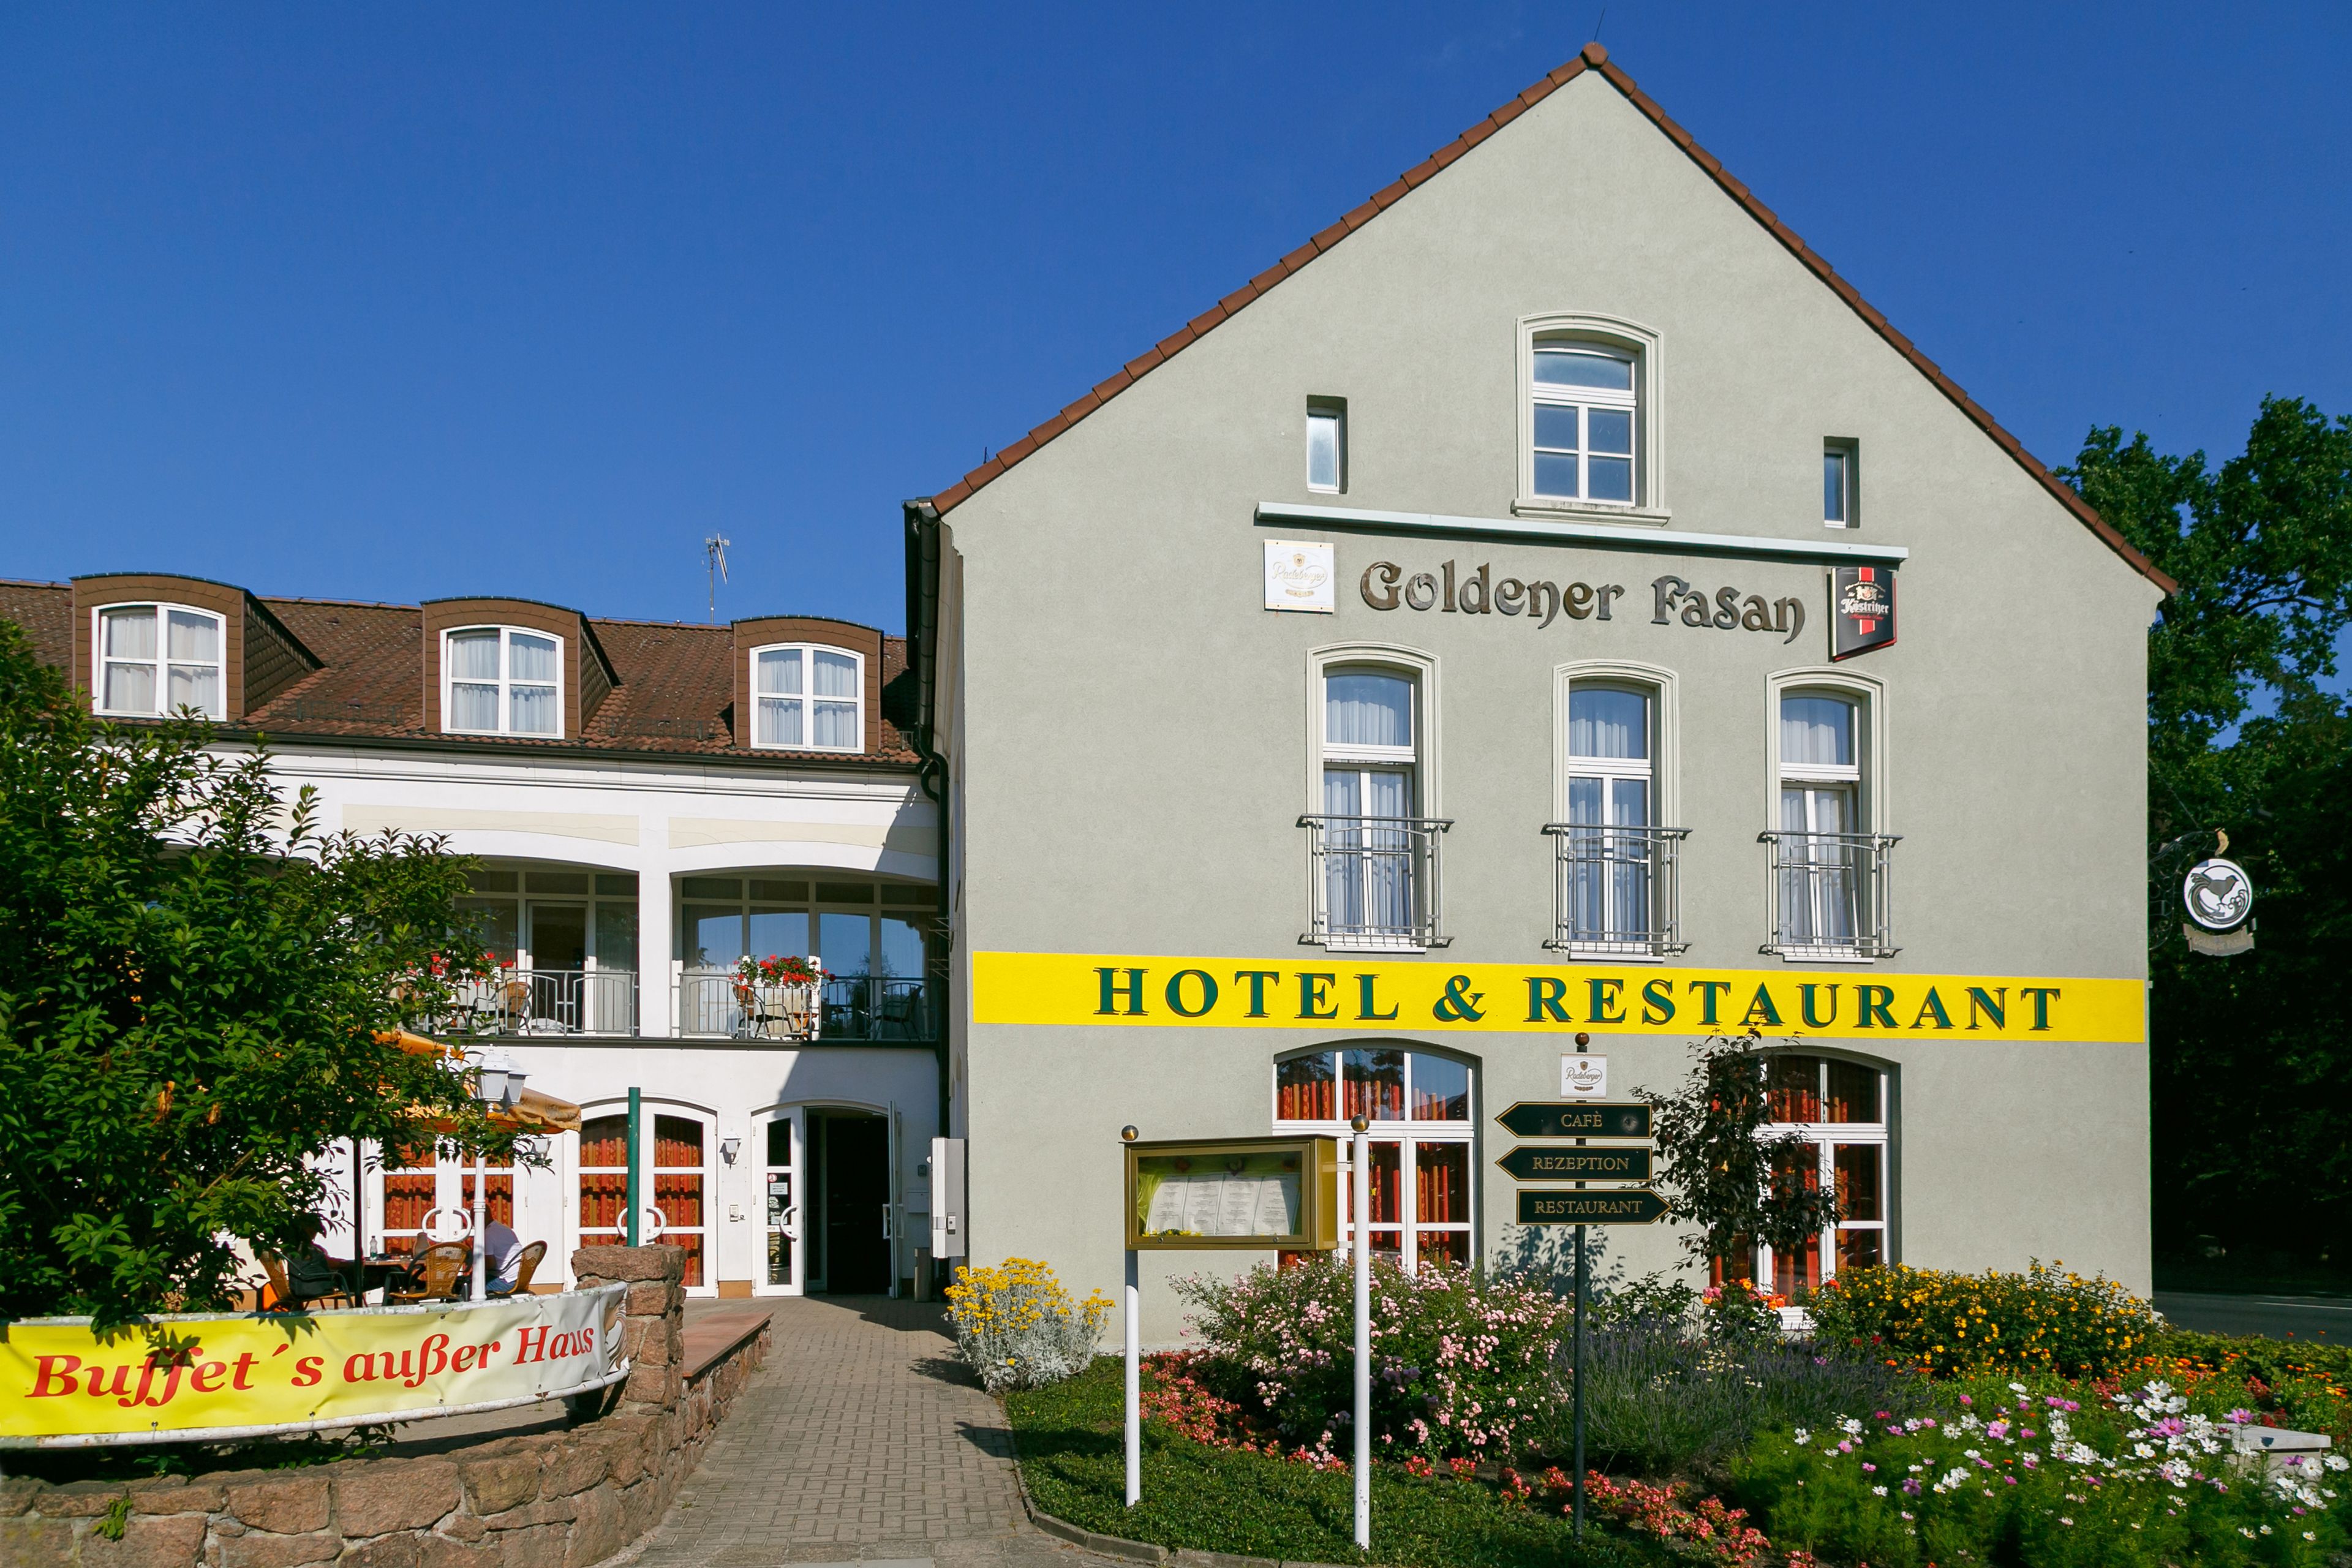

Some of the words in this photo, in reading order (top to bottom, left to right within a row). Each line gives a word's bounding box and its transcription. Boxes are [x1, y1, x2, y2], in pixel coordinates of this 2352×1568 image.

[1360, 559, 1624, 629] Goldener
[1651, 575, 1806, 644] Fasan
[1840, 598, 1889, 615] Köstritzer
[1093, 967, 1400, 1020] HOTEL
[1432, 974, 1487, 1022] &
[1523, 976, 2062, 1031] RESTAURANT
[1566, 1067, 1602, 1085] Radeberger
[1532, 1157, 1629, 1170] REZEPTION
[1534, 1200, 1643, 1215] RESTAURANT
[343, 1333, 502, 1389] außer
[513, 1325, 594, 1366] Haus
